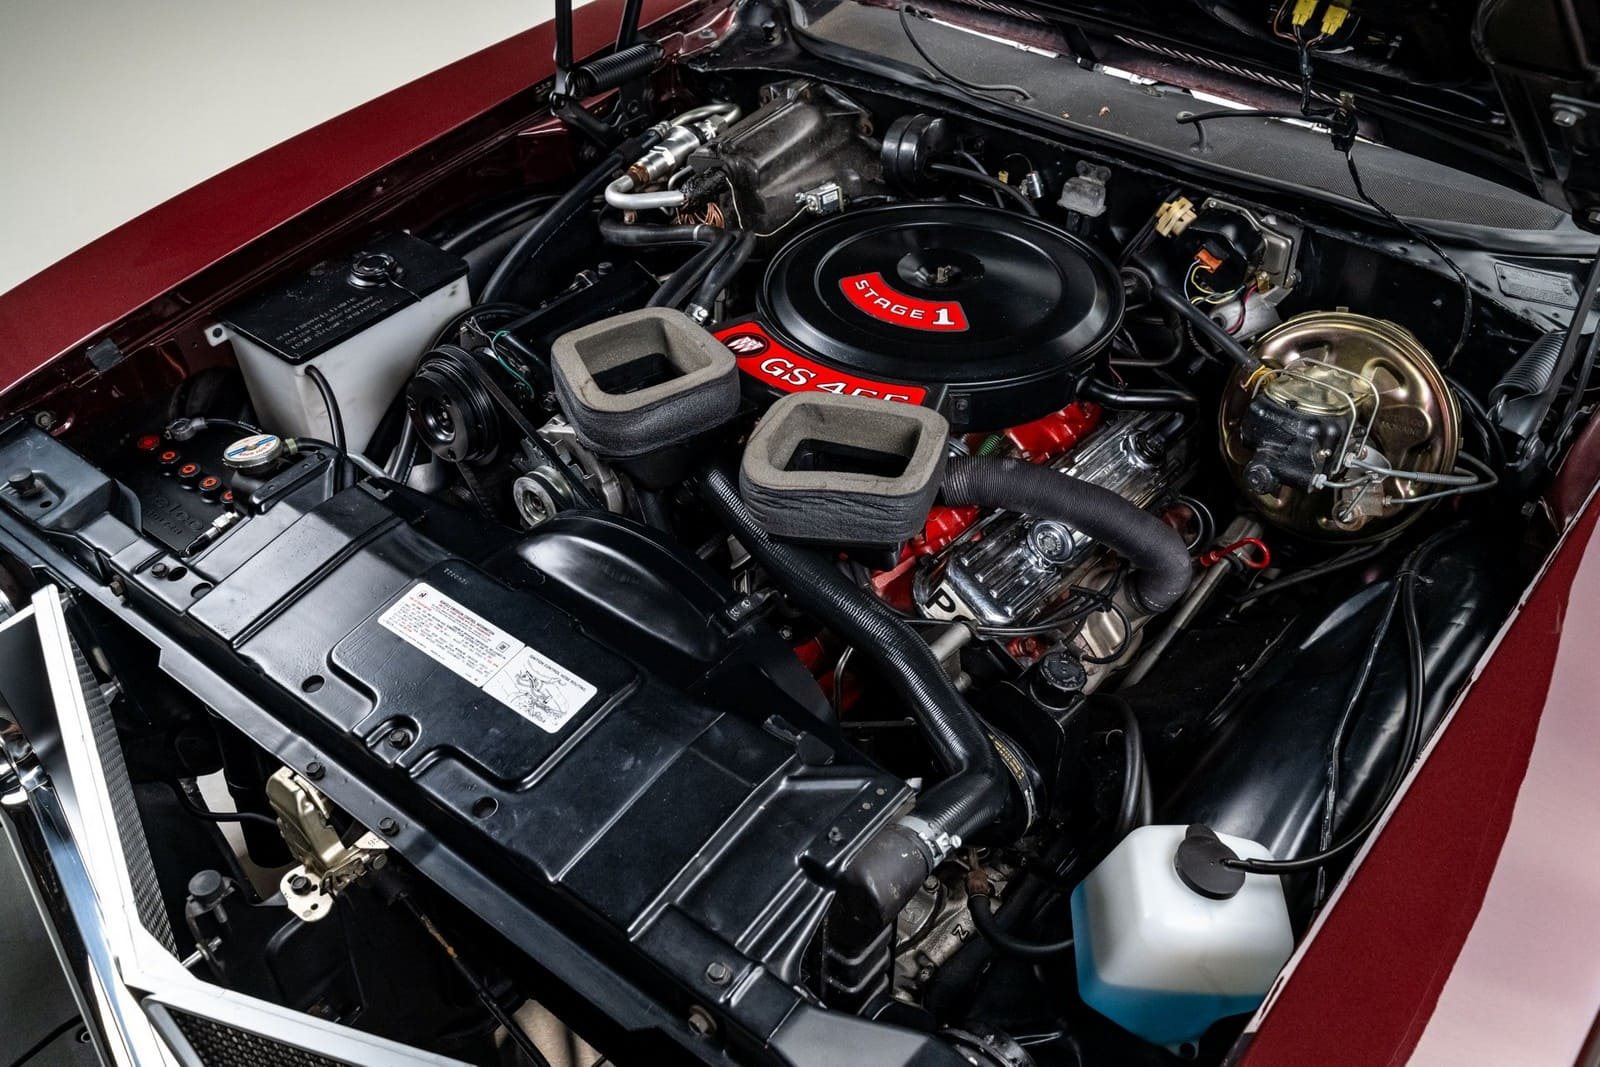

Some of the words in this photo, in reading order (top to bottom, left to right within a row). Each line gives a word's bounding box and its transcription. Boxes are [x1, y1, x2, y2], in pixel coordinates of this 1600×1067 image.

[855, 279, 925, 319] STAGE
[932, 308, 955, 325] 1
[760, 358, 816, 385] GS
